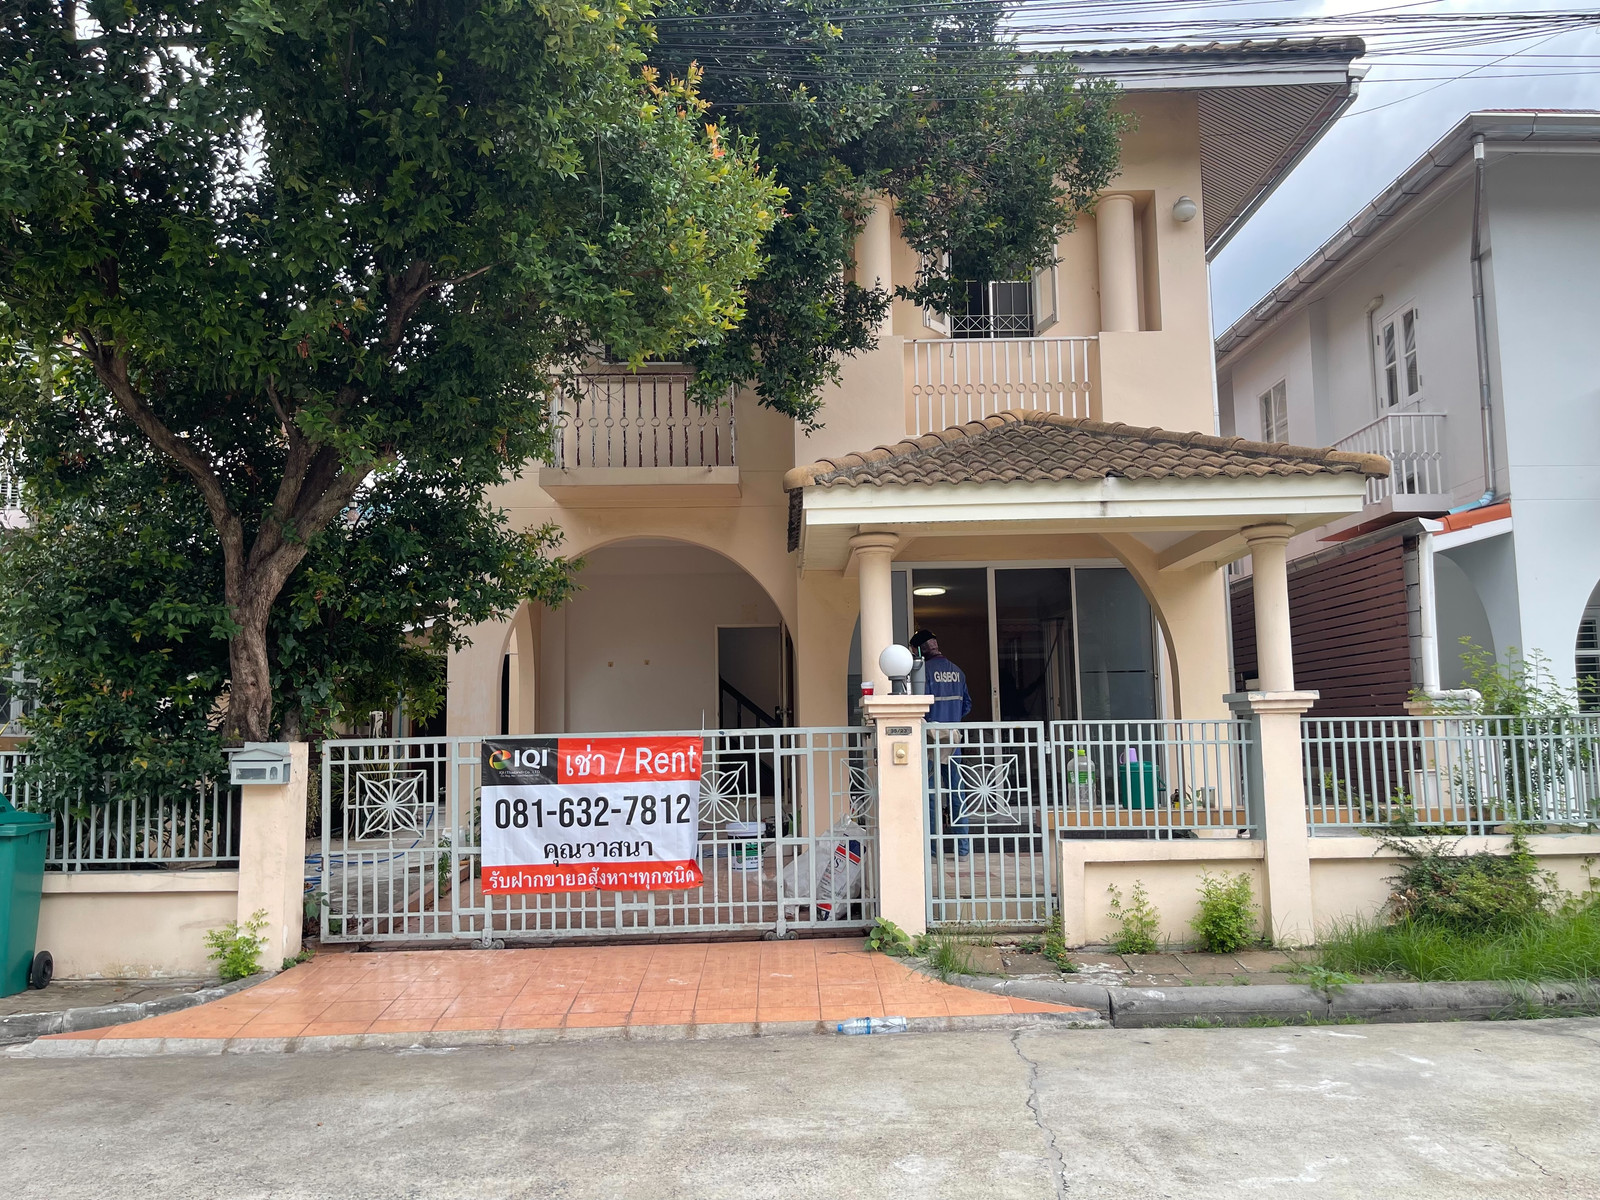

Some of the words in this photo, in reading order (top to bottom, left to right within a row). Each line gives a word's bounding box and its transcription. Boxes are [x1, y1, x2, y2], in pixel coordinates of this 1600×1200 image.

[514, 749, 548, 769] IQI
[566, 744, 606, 776] เช่า
[614, 747, 626, 775] /
[635, 745, 697, 774] Rent
[495, 793, 691, 829] 081-632-7812
[543, 840, 653, 867] คุณวาสนา
[488, 865, 695, 890] รับฝากขายอสังหาฯทุกชนิด
